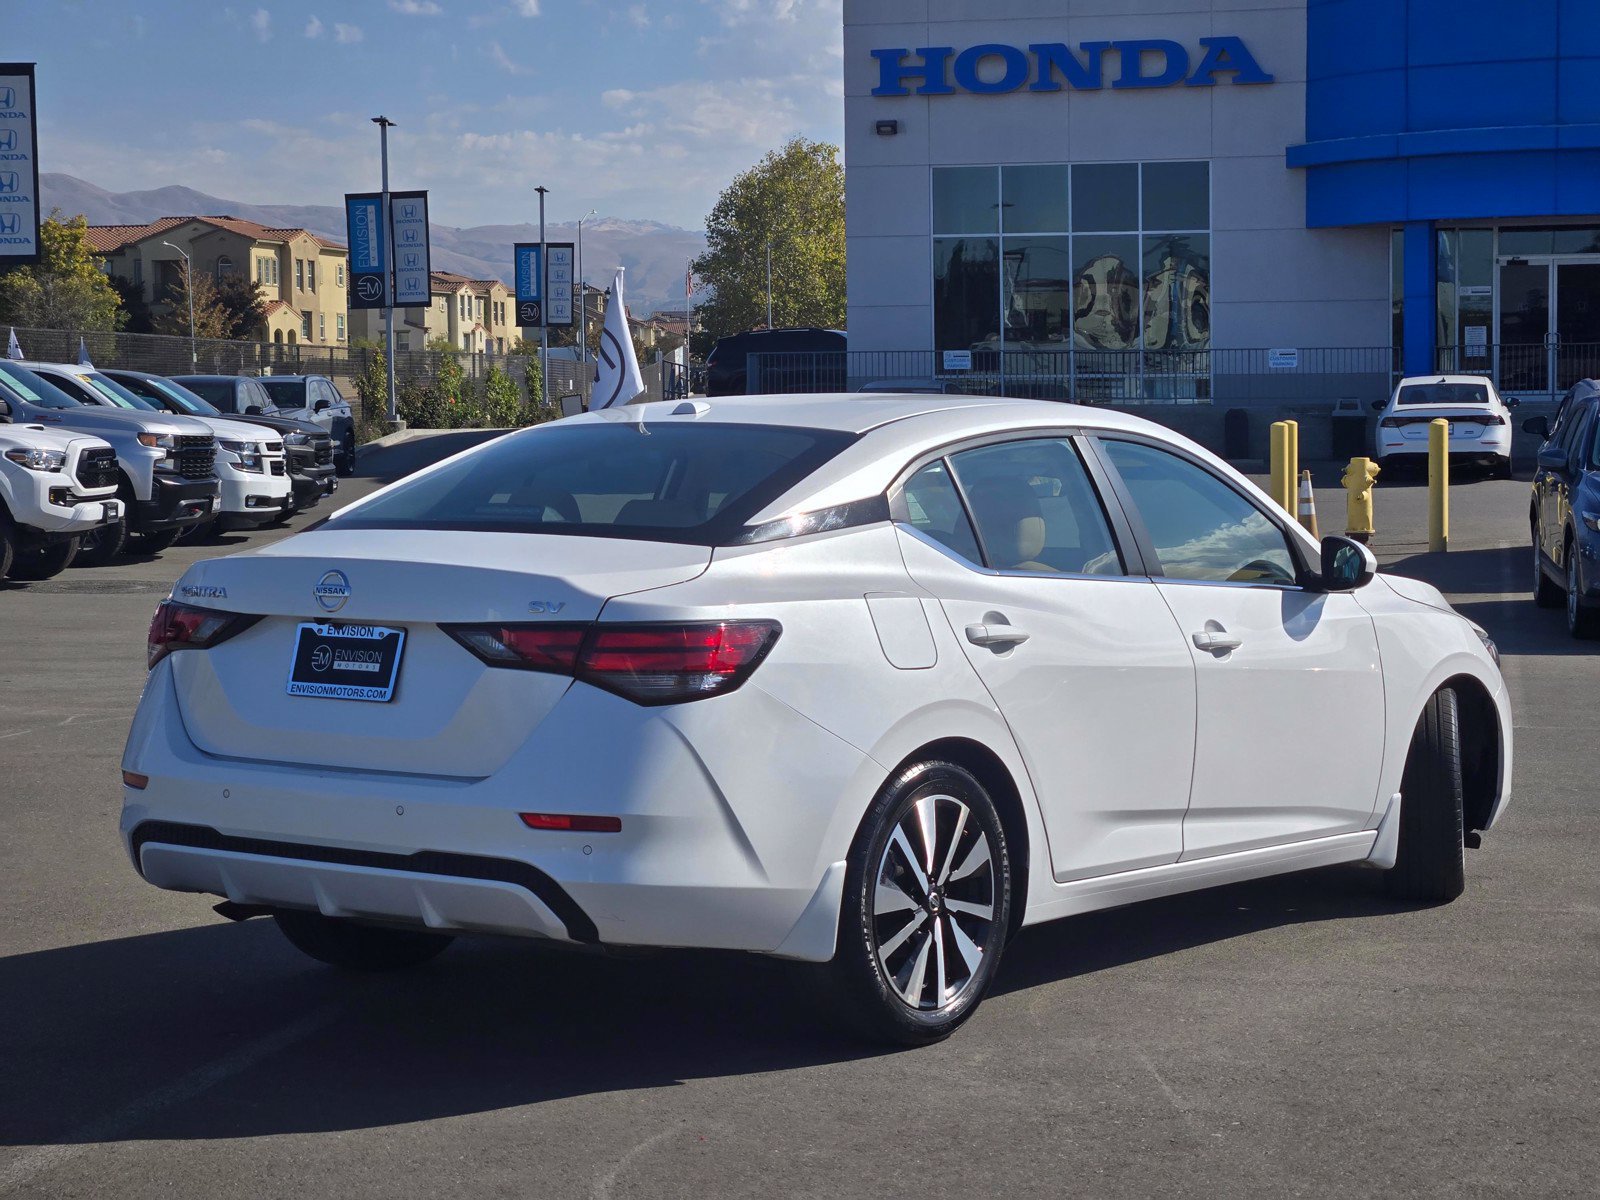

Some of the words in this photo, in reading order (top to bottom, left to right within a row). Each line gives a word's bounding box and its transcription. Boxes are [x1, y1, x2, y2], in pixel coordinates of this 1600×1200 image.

[870, 36, 1275, 97] HONDA
[355, 205, 370, 268] ENVISION
[521, 251, 531, 297] ENVISION
[315, 586, 346, 596] NISSAN
[528, 600, 566, 614] SV
[327, 624, 375, 638] ENVISION
[334, 648, 383, 663] ENVISION
[336, 662, 377, 670] MOTORS
[290, 683, 387, 700] ENVISIONMOTORS.COM
